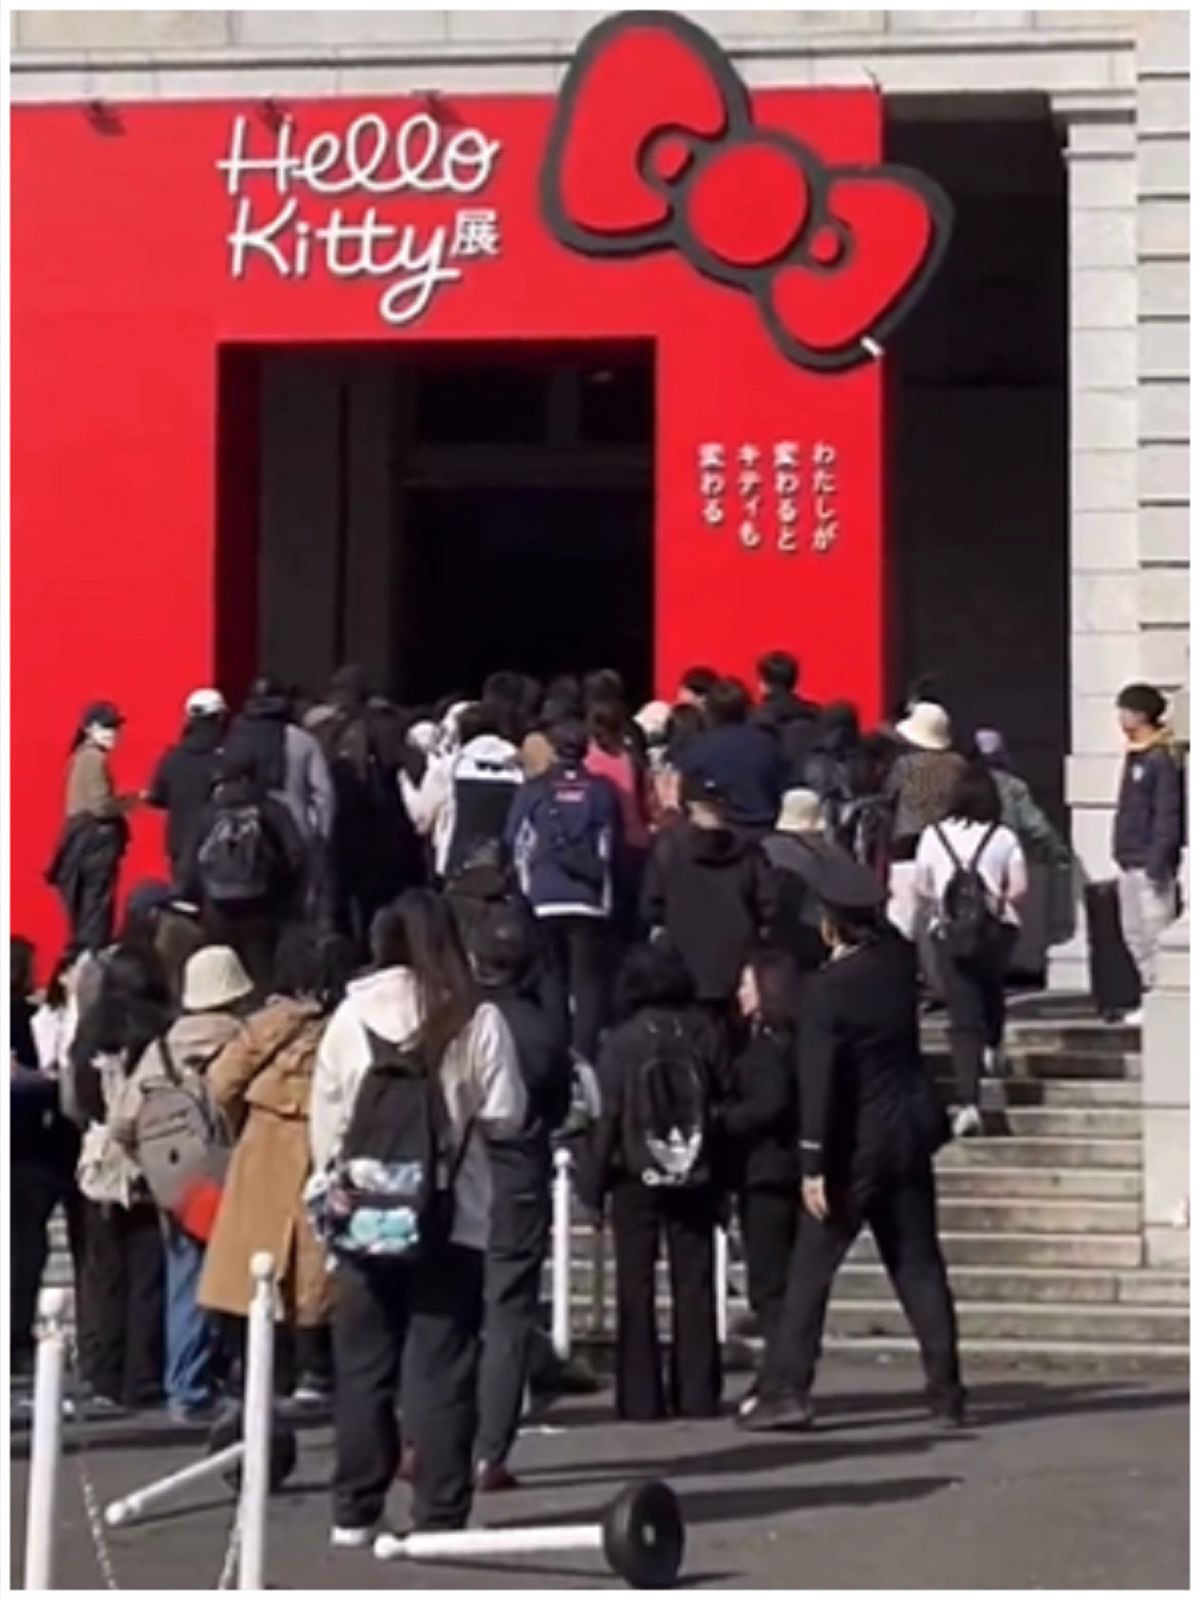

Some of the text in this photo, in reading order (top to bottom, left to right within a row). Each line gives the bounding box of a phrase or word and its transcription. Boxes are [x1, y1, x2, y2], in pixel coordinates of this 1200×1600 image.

[215, 112, 501, 196] Hello
[812, 441, 839, 551] わたしが
